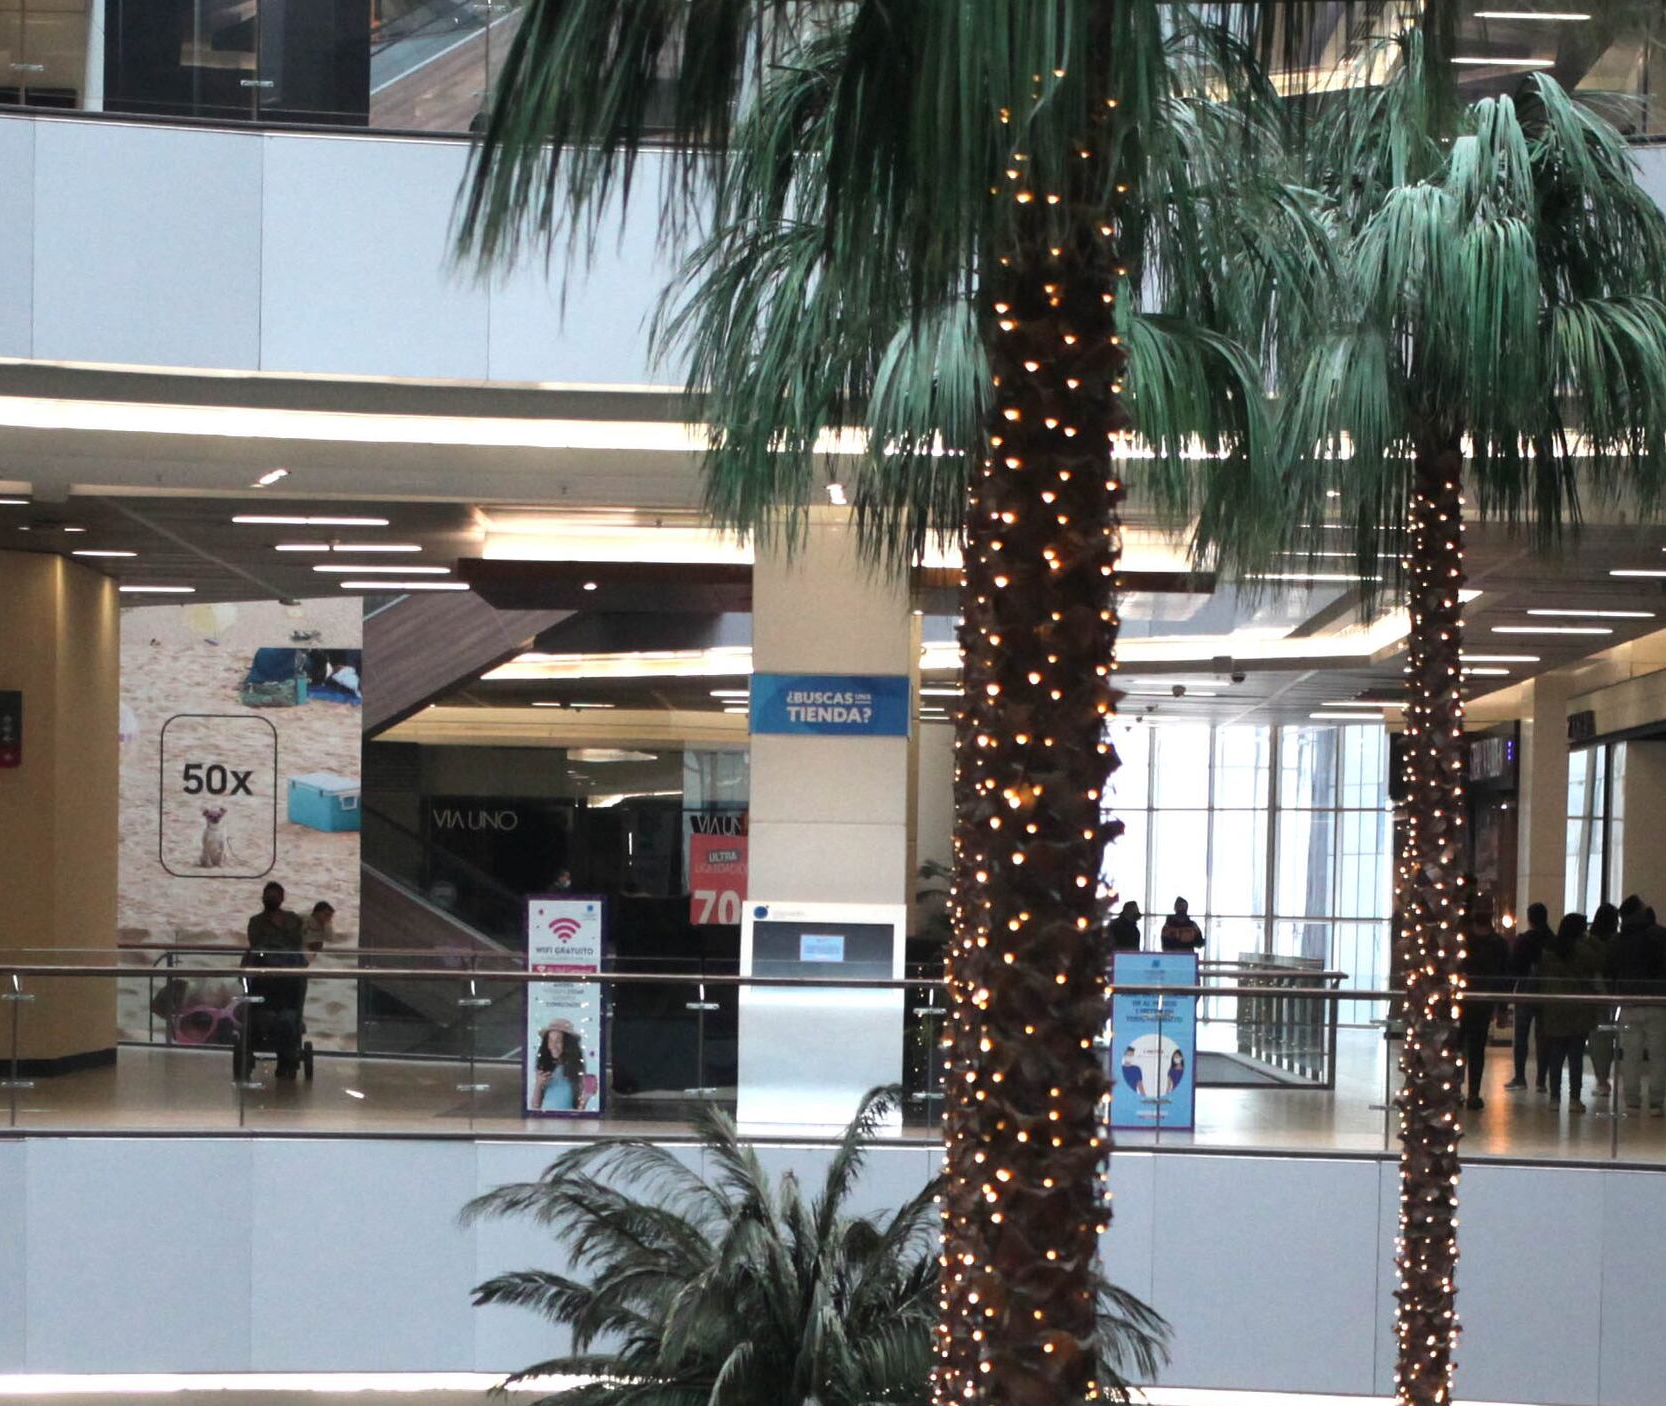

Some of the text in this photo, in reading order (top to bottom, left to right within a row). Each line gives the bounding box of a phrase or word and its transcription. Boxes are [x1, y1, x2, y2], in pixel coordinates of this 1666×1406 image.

[786, 691, 854, 705] ¿BUSCAS
[786, 706, 872, 724] TIENDA?
[182, 763, 254, 796] 50x
[433, 809, 519, 832] VIA UNO
[696, 815, 741, 837] VIA UN
[708, 850, 738, 863] ULTRA
[694, 889, 741, 925] 70
[535, 946, 594, 956] WIFI GRATUITO
